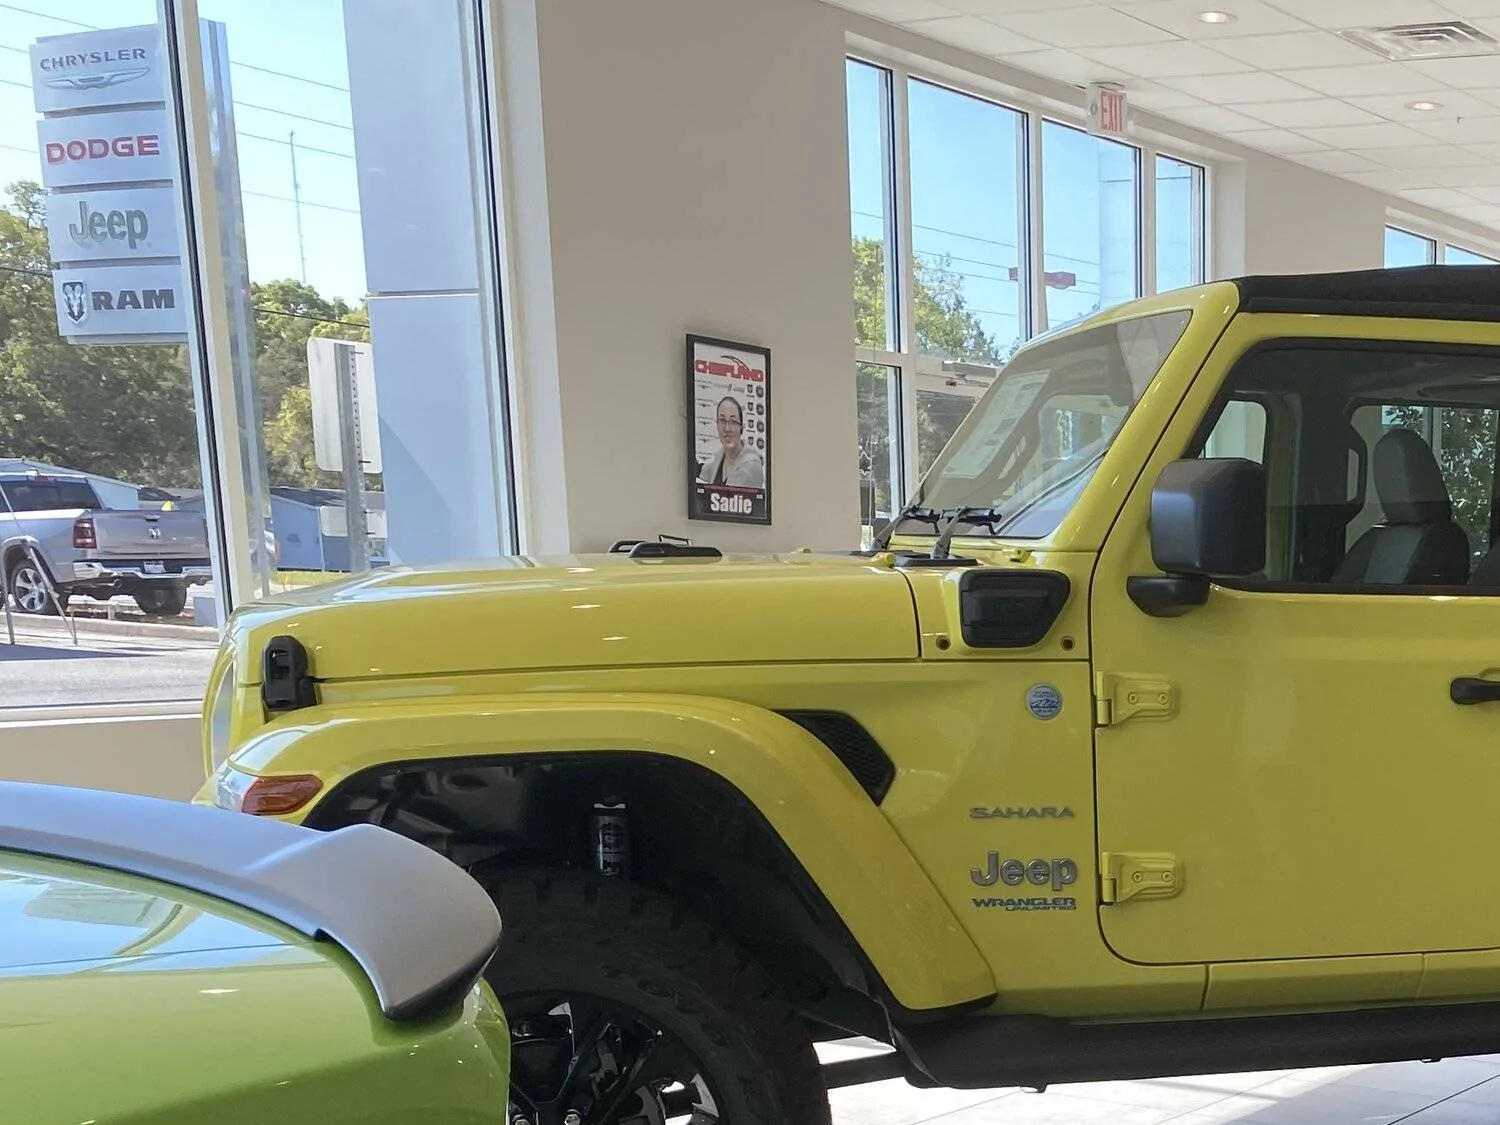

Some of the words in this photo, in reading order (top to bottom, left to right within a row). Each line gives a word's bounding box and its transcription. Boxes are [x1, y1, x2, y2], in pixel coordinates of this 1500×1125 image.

[40, 48, 147, 71] CHRYSLER
[1101, 90, 1124, 132] EXIT
[46, 135, 160, 164] DODGE
[69, 201, 149, 249] Jeep
[92, 289, 175, 311] RAM
[711, 493, 752, 514] Sadie
[969, 807, 1075, 819] SAHARA
[970, 851, 1078, 891] Jeep
[971, 898, 1077, 907] WRANGLER
